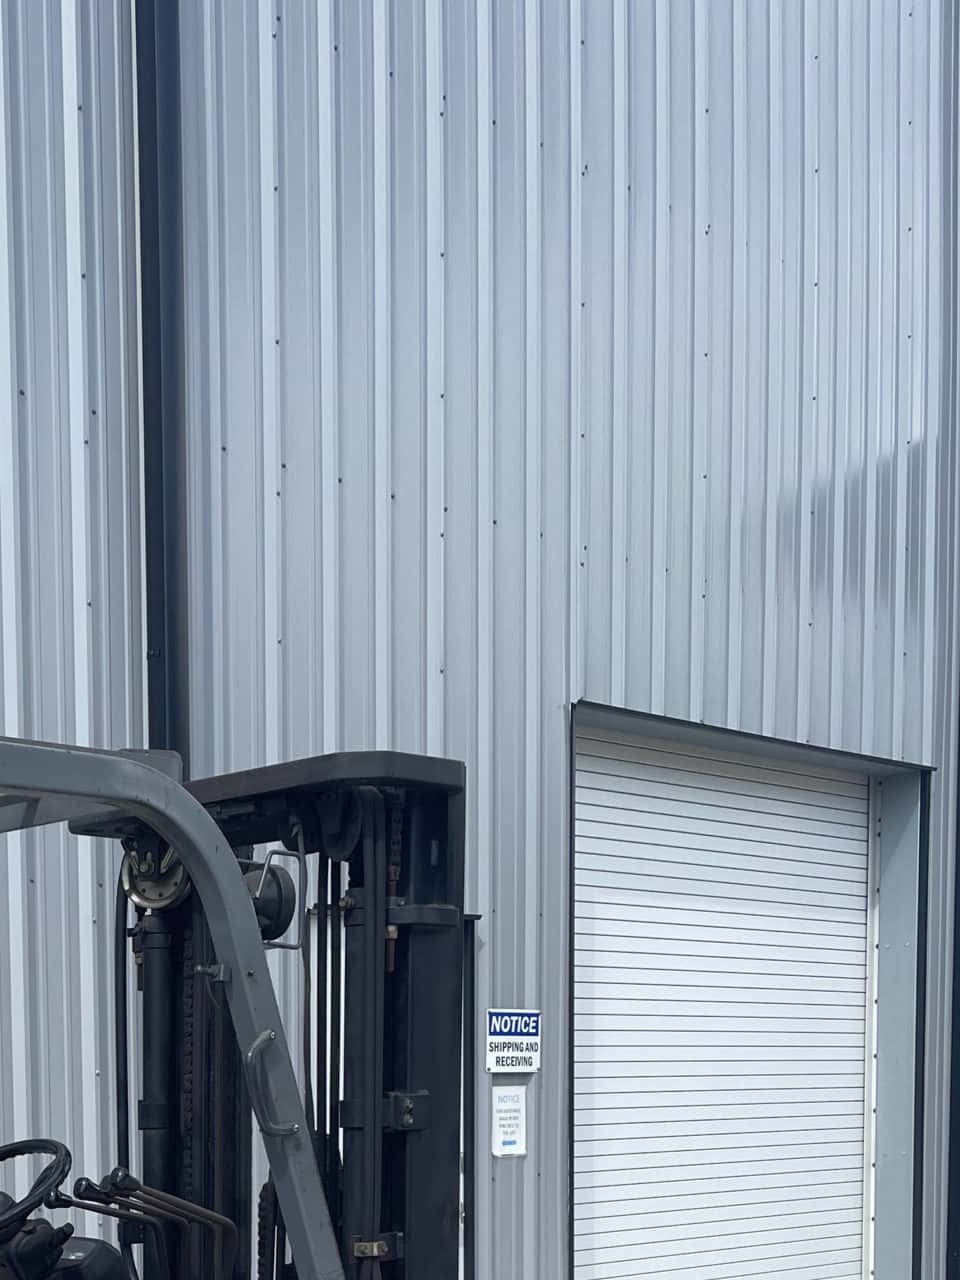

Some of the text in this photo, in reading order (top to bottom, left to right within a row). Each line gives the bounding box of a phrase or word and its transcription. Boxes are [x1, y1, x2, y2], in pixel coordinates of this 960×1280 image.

[491, 1015, 537, 1033] NOTICE
[489, 1041, 539, 1052] SHIPPING AND
[496, 1056, 533, 1067] RECEIVING
